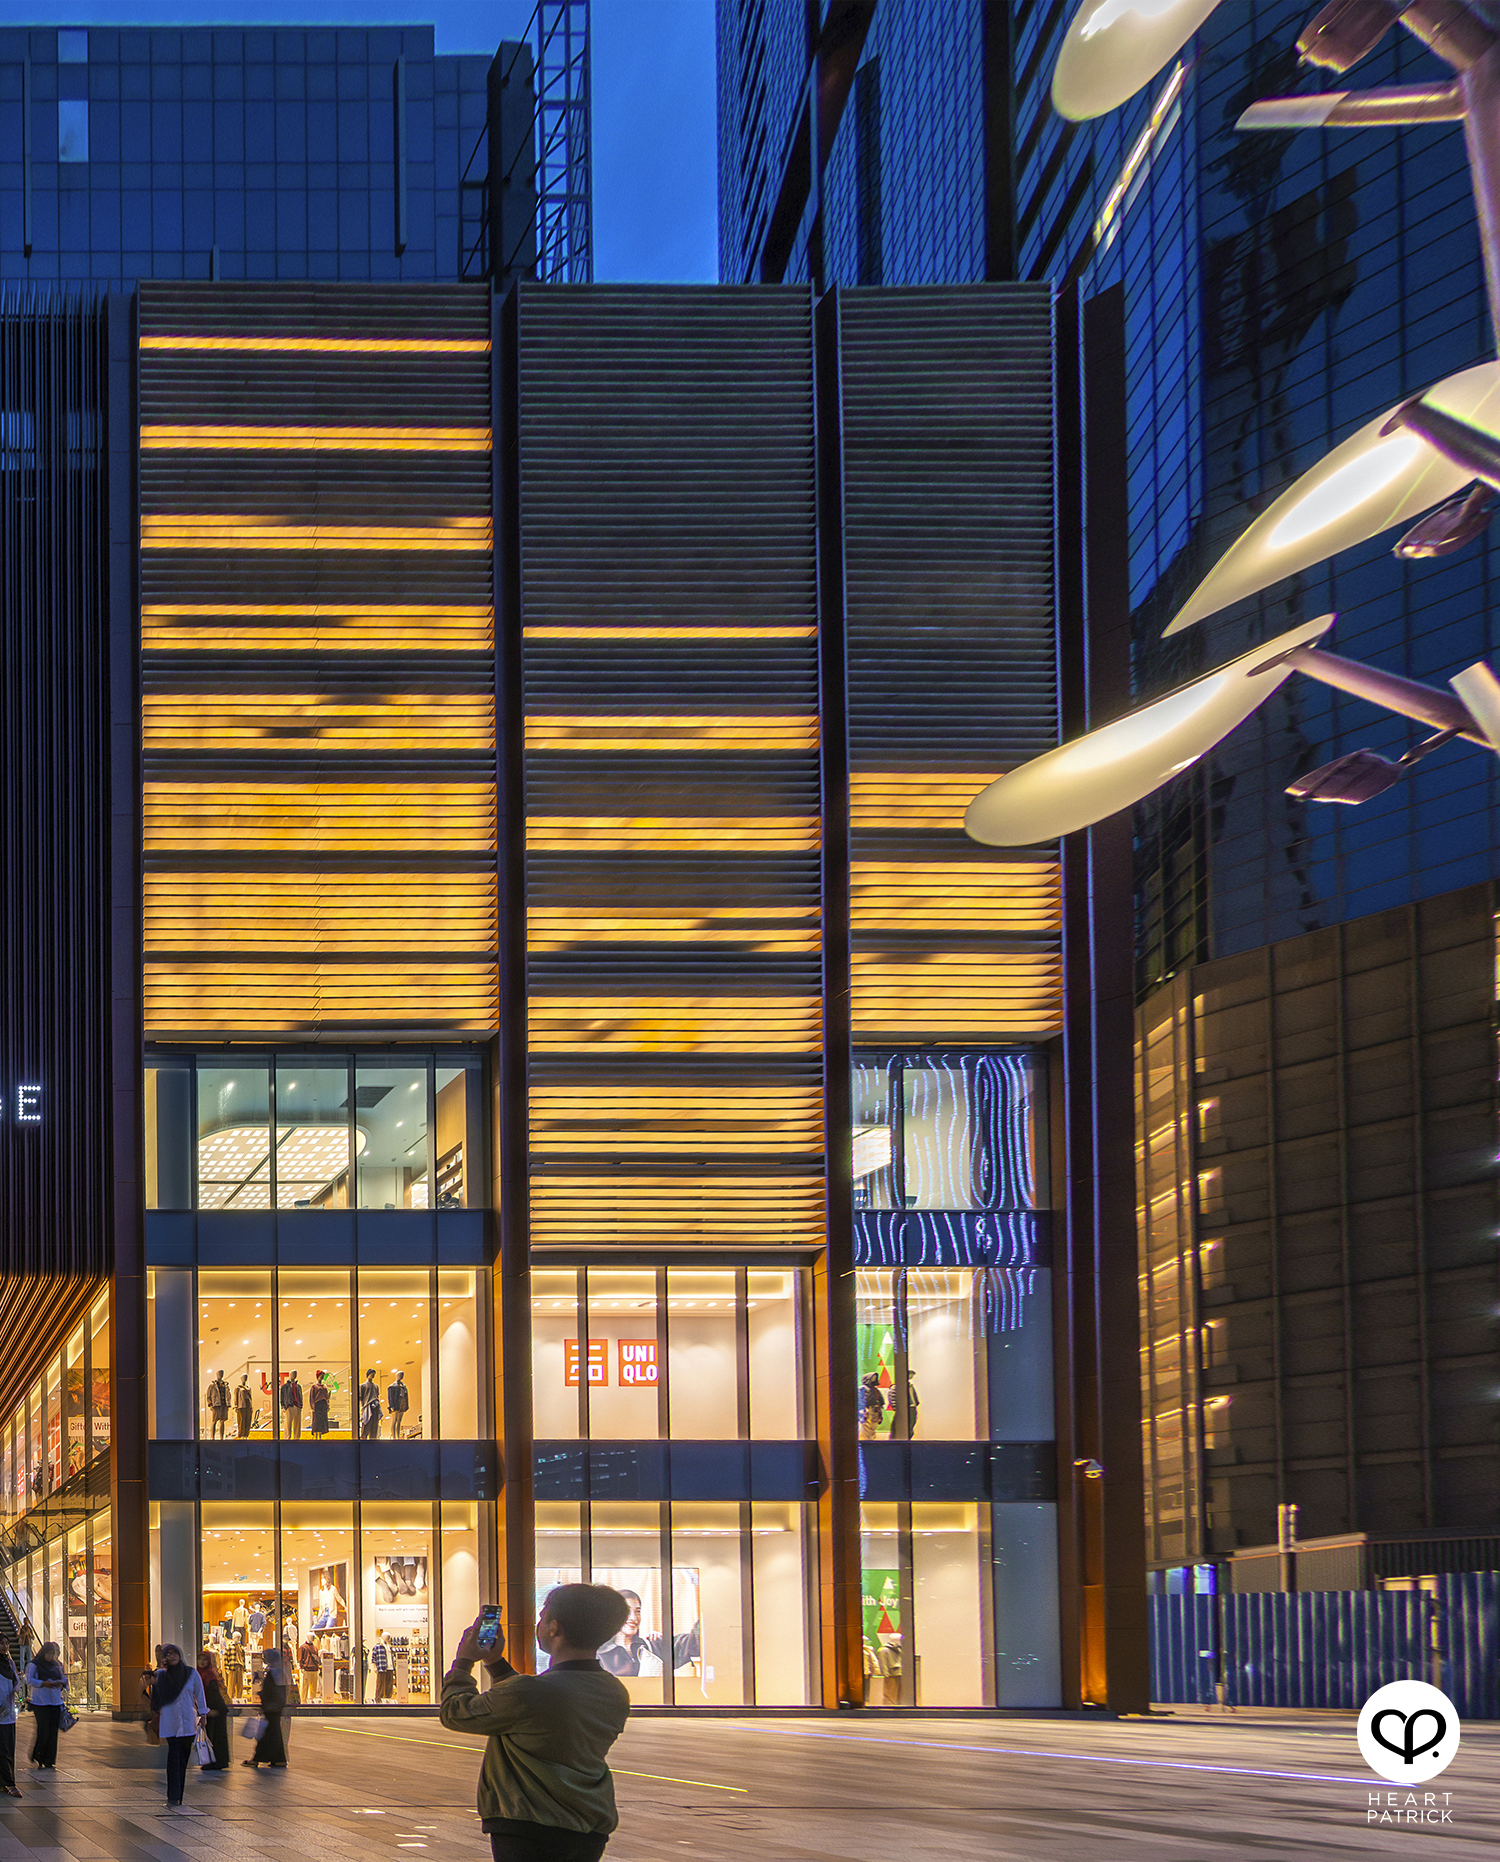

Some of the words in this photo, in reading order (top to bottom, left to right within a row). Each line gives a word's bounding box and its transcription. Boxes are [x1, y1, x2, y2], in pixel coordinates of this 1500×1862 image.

[622, 1345, 655, 1362] UNI
[622, 1364, 658, 1384] QLO
[862, 1595, 877, 1606] ith
[879, 1595, 899, 1609] Joy
[73, 1622, 87, 1631] Gift
